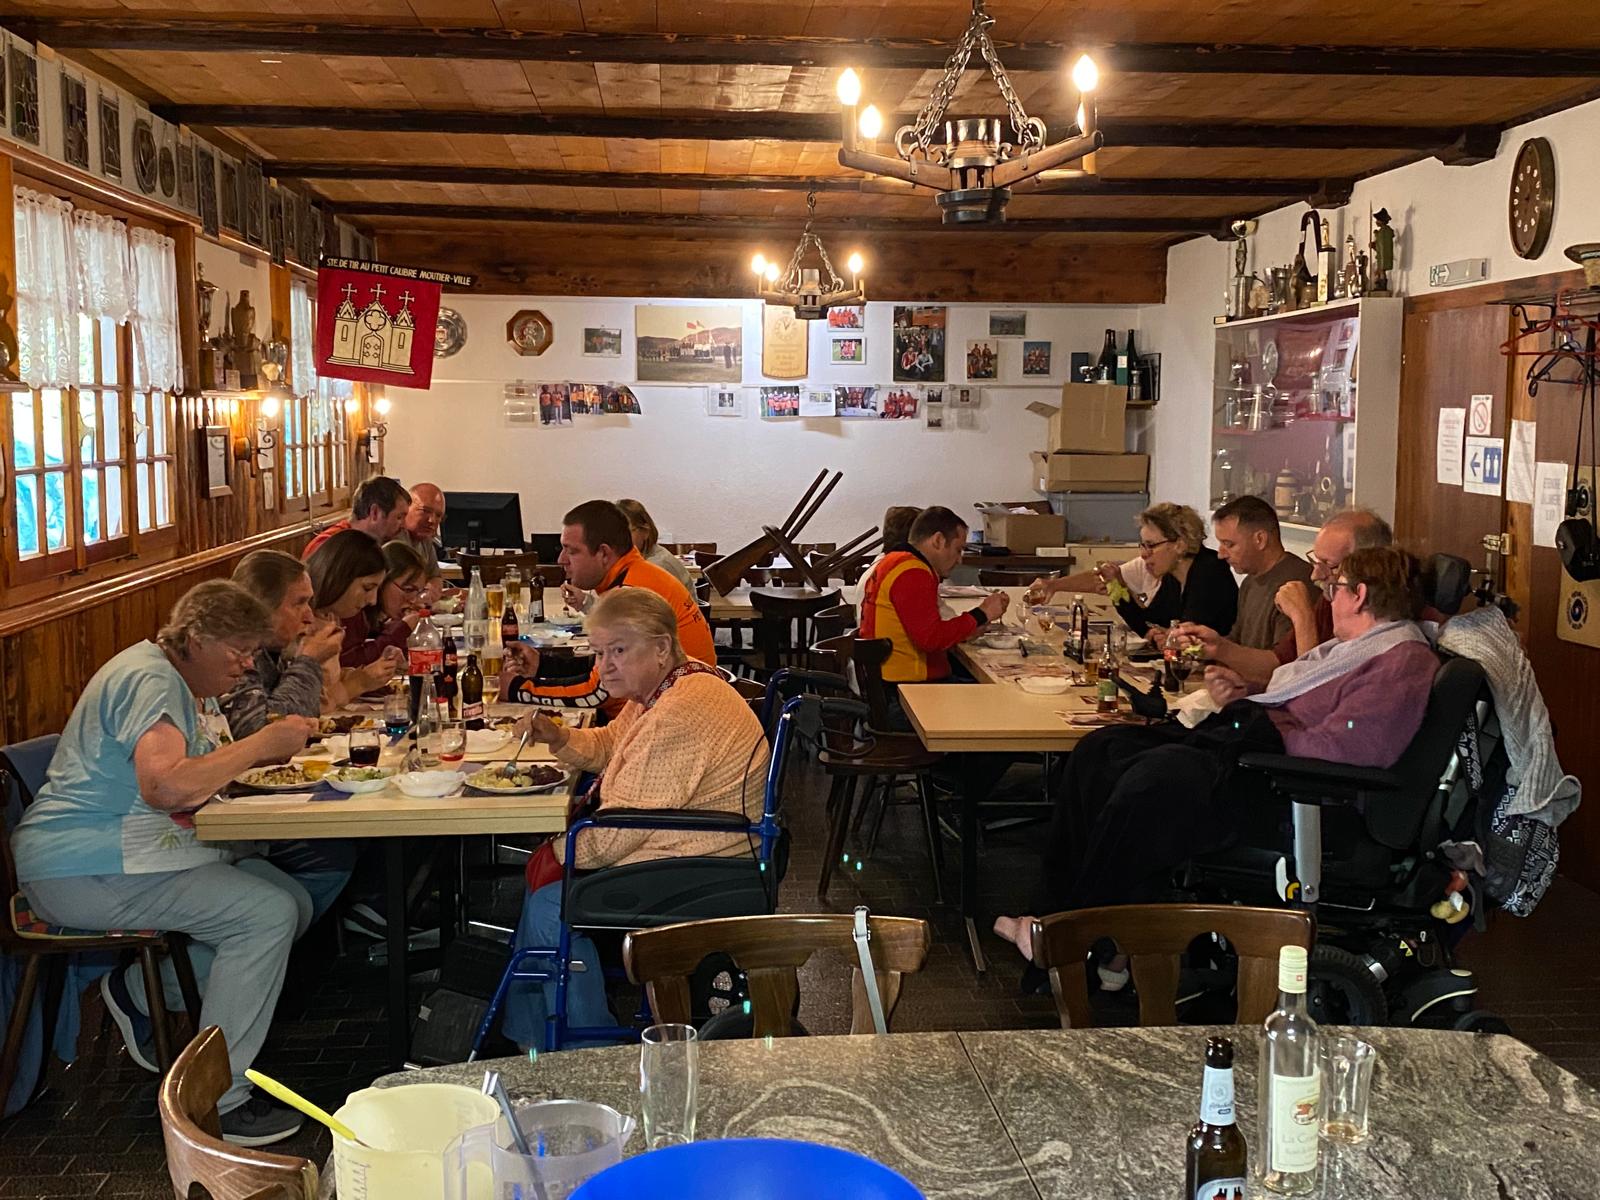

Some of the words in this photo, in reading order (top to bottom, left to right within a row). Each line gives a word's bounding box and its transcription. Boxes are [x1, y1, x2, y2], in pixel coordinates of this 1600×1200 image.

[349, 260, 359, 270] TIR
[360, 262, 370, 271] AU
[371, 263, 389, 274] PETIT
[389, 266, 417, 278] CALIBRE
[419, 270, 471, 286] MOUTIER-VILLE
